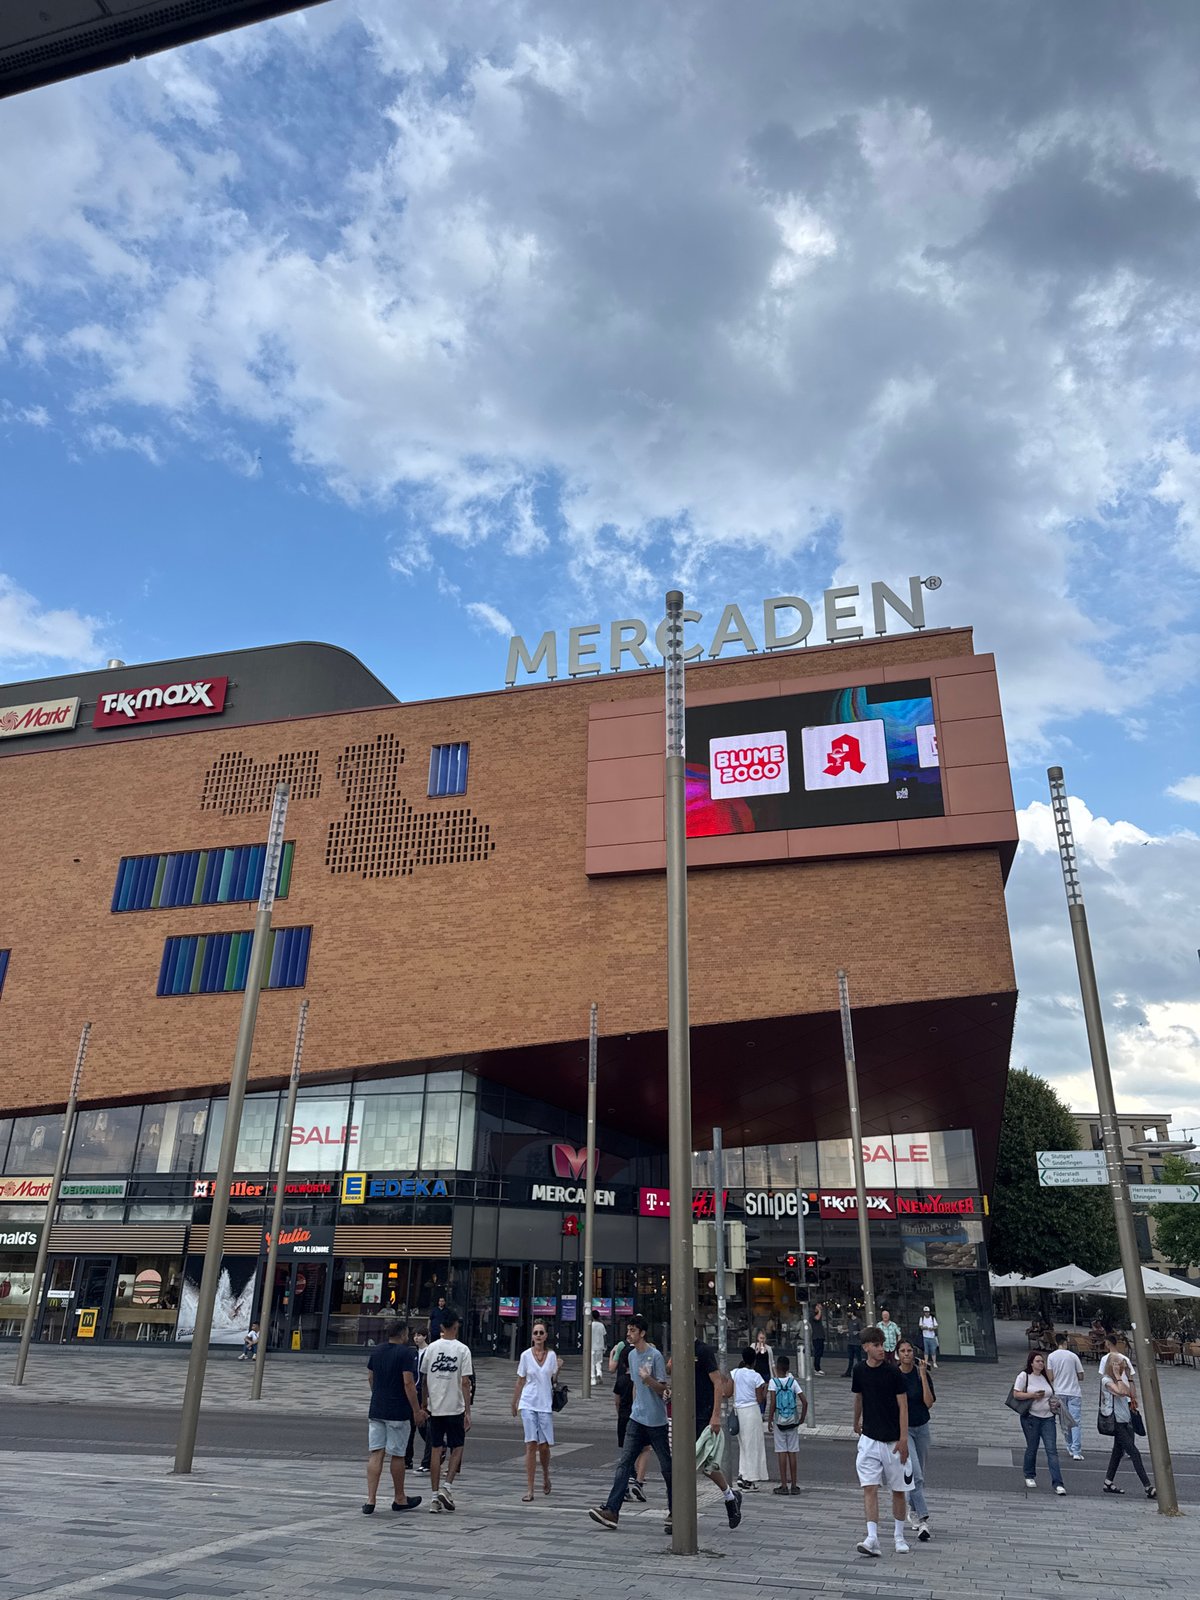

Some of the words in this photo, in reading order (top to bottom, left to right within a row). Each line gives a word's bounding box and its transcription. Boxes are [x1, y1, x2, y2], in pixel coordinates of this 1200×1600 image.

[715, 745, 784, 769] BLUME
[720, 763, 780, 784] 2000
[290, 1125, 359, 1145] SALE
[12, 1180, 52, 1196] Markt
[62, 1185, 124, 1195] DEICHMANN
[369, 1179, 448, 1197] EDEKA
[531, 1184, 616, 1207] MERCAEN
